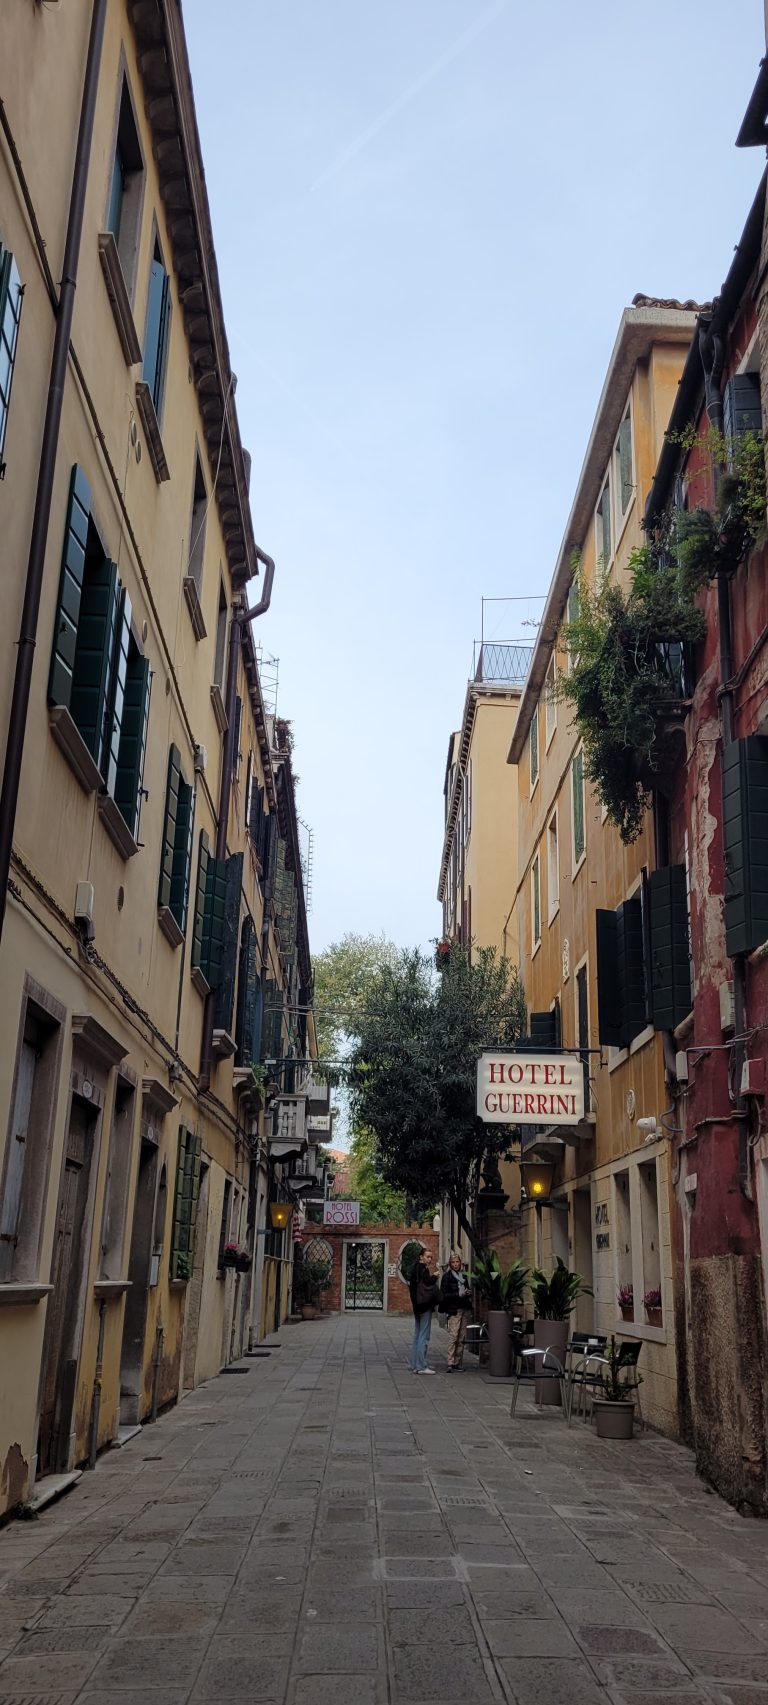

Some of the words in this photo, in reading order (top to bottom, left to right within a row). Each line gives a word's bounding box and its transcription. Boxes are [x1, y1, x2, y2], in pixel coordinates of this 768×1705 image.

[488, 1063, 573, 1085] HOTEL
[484, 1092, 577, 1115] GUERRINI
[331, 1202, 352, 1211] HOTEL
[326, 1211, 358, 1224] ROSSI
